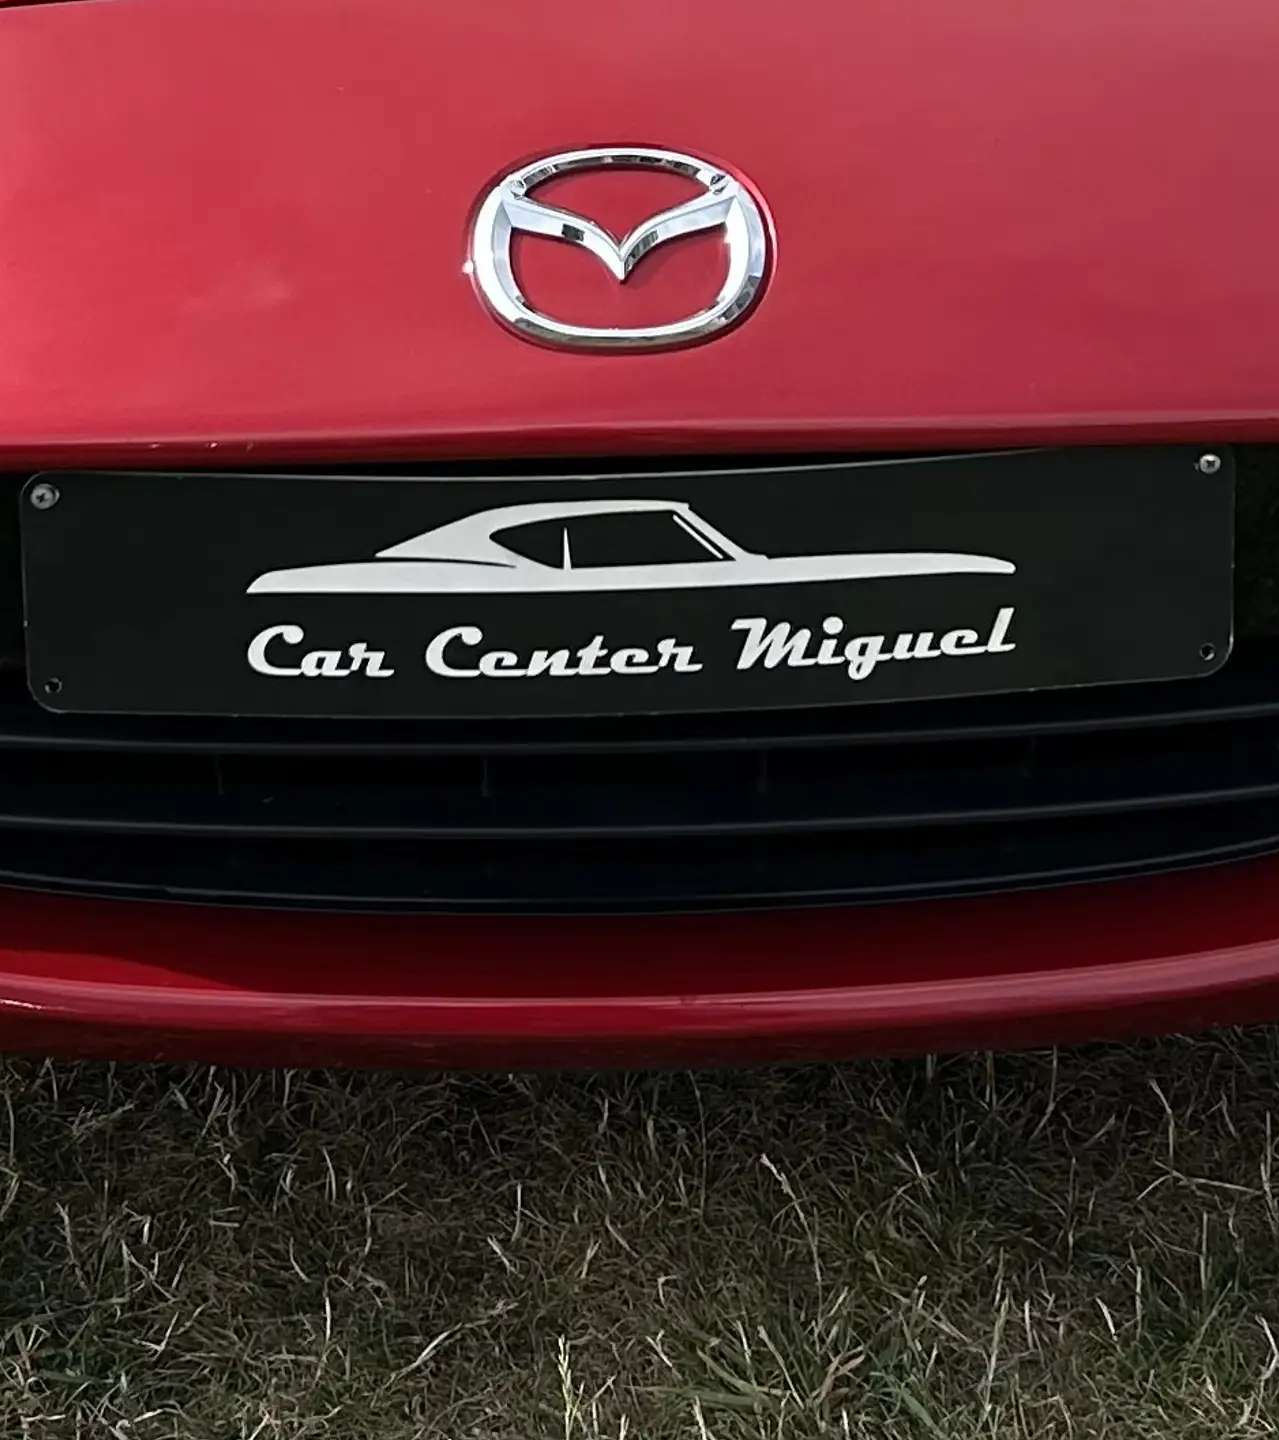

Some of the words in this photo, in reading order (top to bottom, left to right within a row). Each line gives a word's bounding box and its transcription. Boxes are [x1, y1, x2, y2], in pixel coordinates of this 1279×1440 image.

[247, 624, 395, 678] Car
[425, 626, 703, 678] Center
[730, 607, 1017, 681] Miguel
